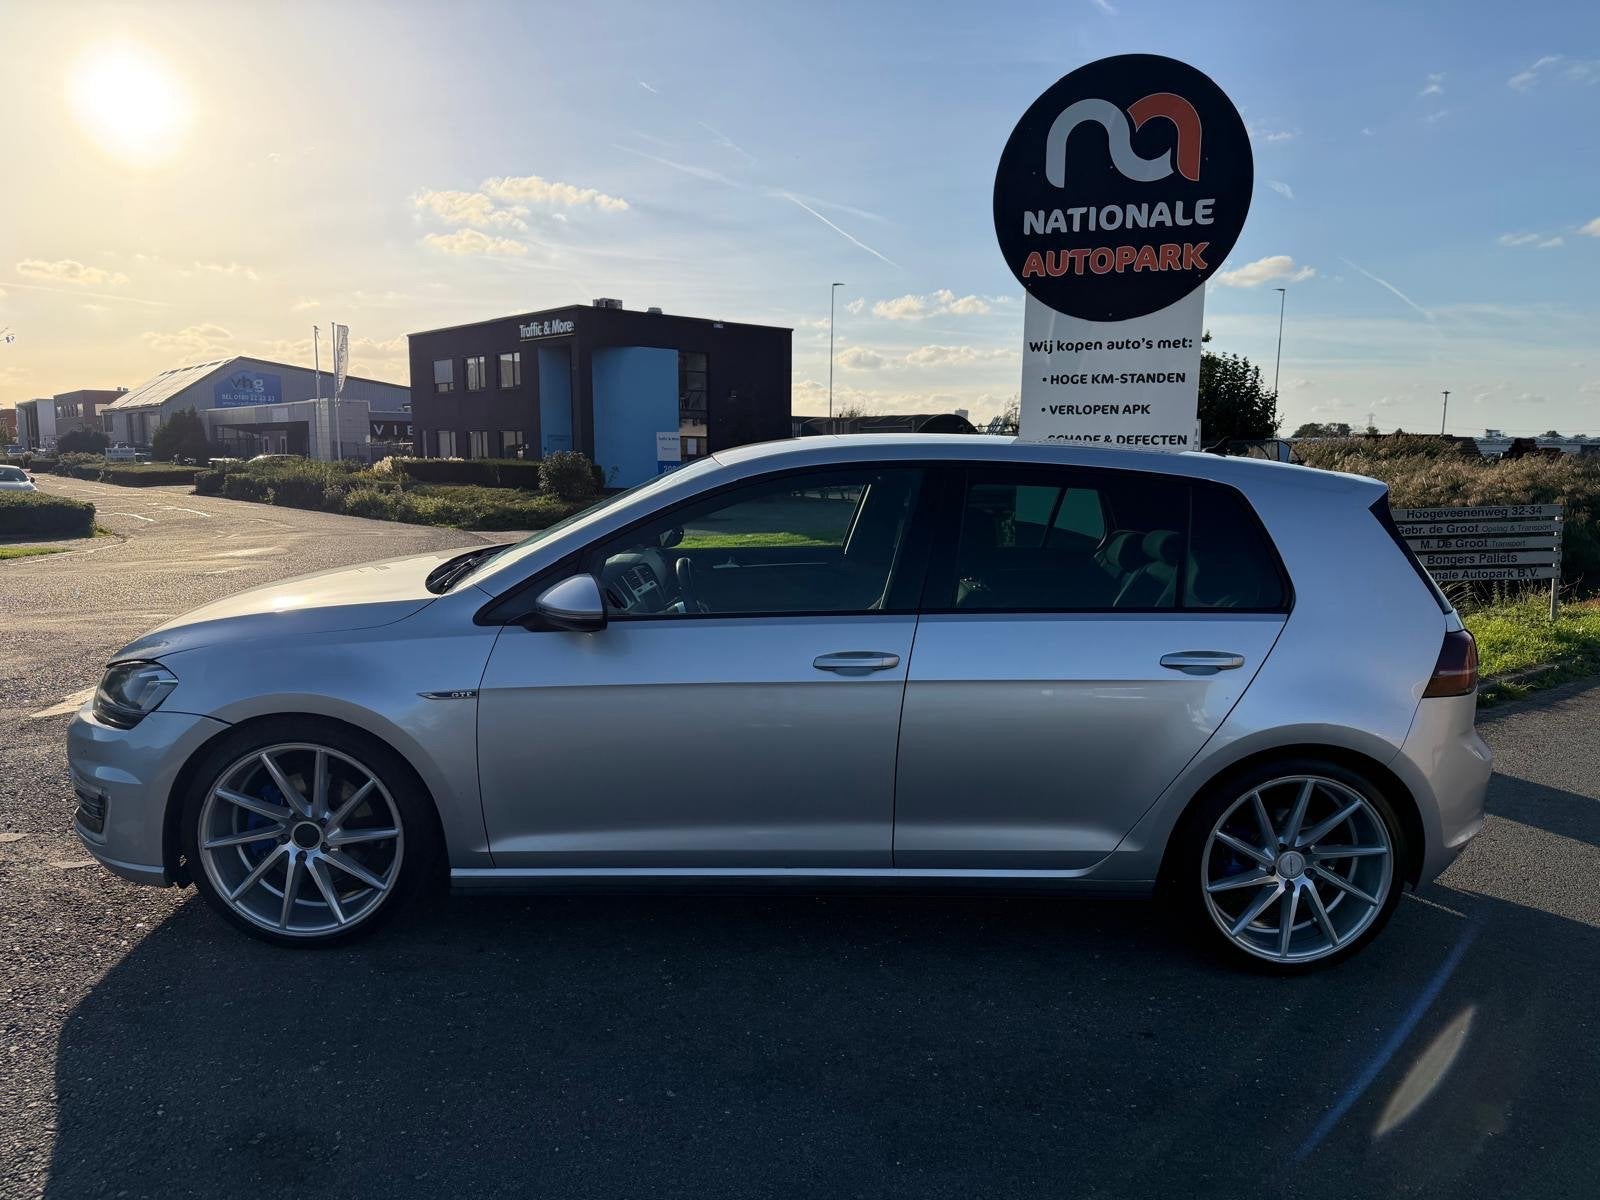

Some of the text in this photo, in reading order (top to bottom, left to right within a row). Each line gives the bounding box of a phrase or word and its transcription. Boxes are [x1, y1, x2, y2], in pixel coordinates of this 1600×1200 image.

[1023, 198, 1216, 236] NATIONALE
[1022, 241, 1210, 278] AUTOPARK
[519, 318, 572, 339] Traffic & More
[1029, 337, 1193, 355] Wij kopen auto's met:
[1050, 373, 1186, 385] HOGE KM-STANDEN
[1049, 404, 1151, 415] VERLOPEN APK
[1116, 434, 1188, 446] DEFECTEN
[1406, 506, 1542, 520] Hoogeveenenweg 32-34
[1429, 525, 1445, 534] de
[1447, 523, 1479, 534] Groot
[1518, 524, 1552, 532] Transport
[1420, 540, 1433, 549] M.
[1437, 540, 1452, 549] De
[1455, 539, 1488, 549] Groot
[1427, 553, 1518, 566] Bongers Pallets
[1462, 569, 1513, 580] Autopark
[1517, 568, 1539, 578] B.V.
